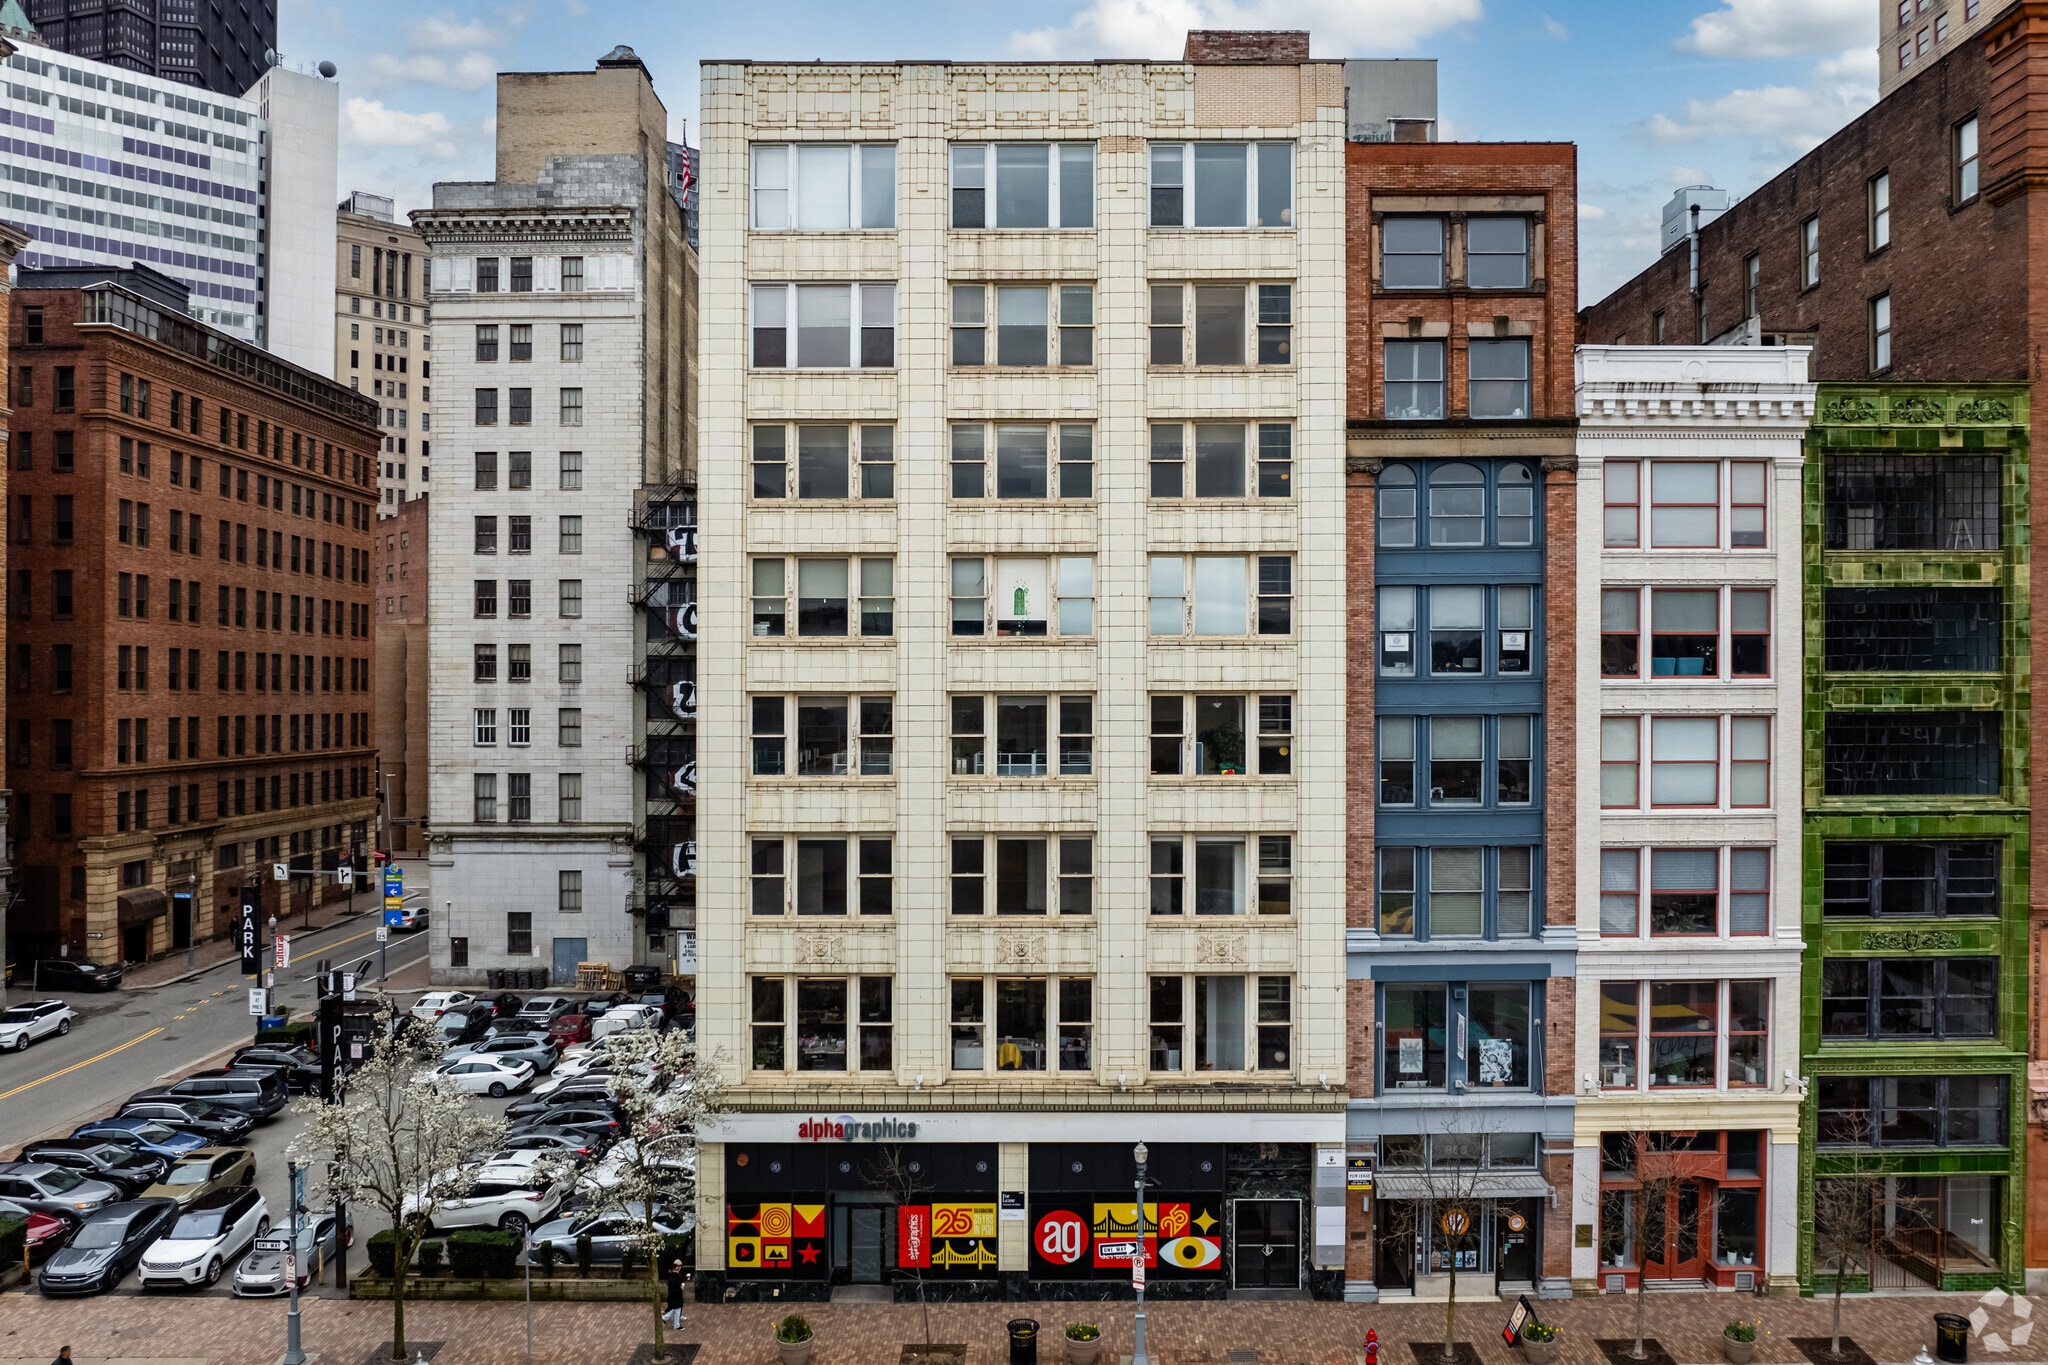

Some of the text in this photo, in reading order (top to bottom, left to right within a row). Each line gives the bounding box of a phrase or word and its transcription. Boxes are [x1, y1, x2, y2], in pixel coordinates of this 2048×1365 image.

[243, 905, 254, 958] PARK
[799, 1117, 917, 1142] alphagraphics
[934, 1208, 973, 1235] 25
[974, 1214, 982, 1225] 25
[981, 1214, 994, 1225] YRS
[974, 1225, 980, 1235] IN
[1160, 1204, 1189, 1237] 25
[258, 1241, 281, 1249] ONE WAY
[1043, 1221, 1080, 1263] ag
